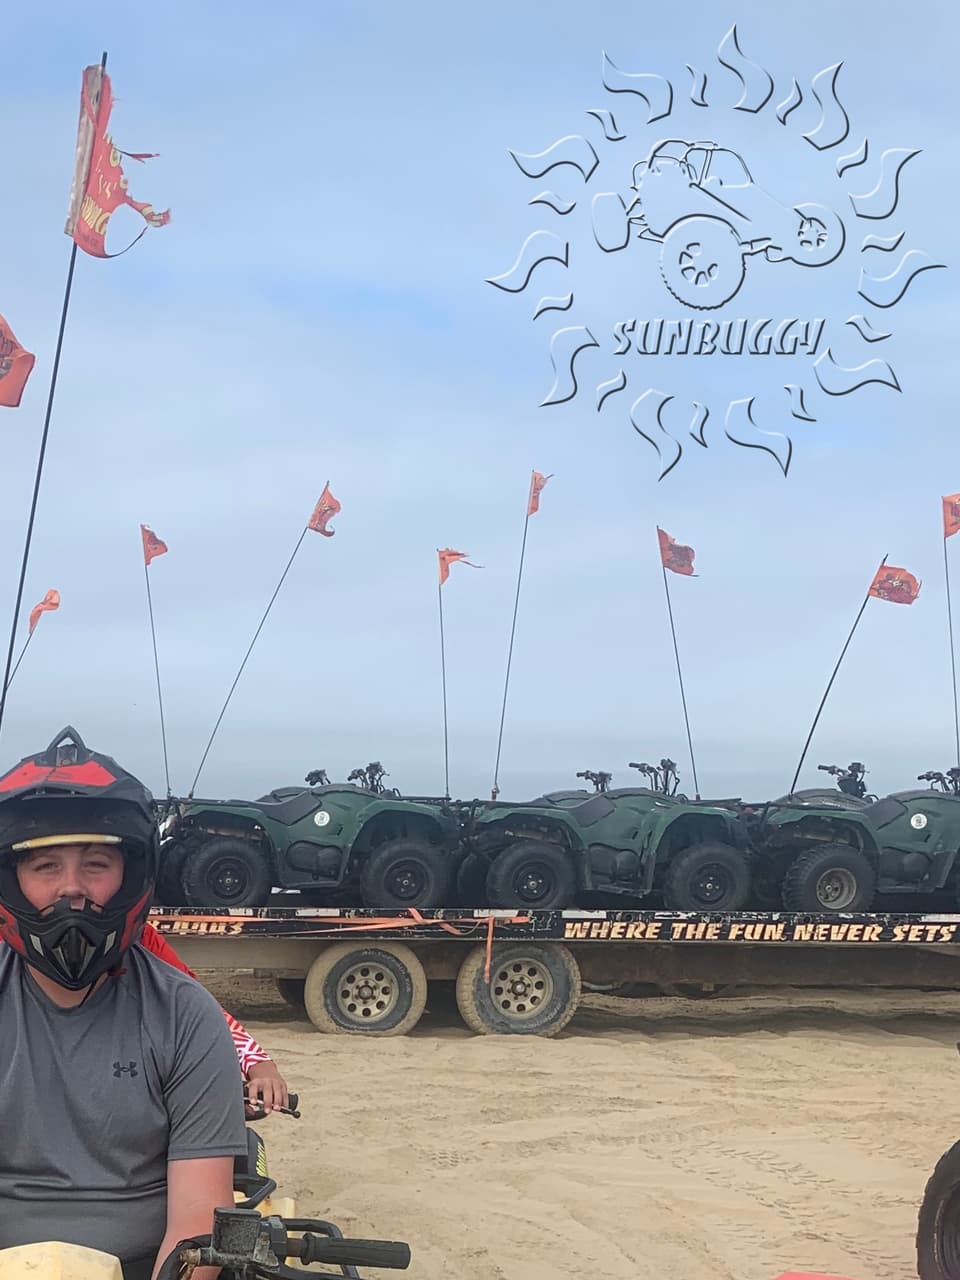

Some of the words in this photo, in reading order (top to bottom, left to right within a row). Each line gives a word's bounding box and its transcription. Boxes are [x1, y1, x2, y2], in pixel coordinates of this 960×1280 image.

[563, 920, 663, 940] WHERE
[670, 921, 725, 941] THE
[727, 922, 785, 942] FUN
[792, 923, 884, 942] NEVER
[890, 924, 958, 943] SETS
